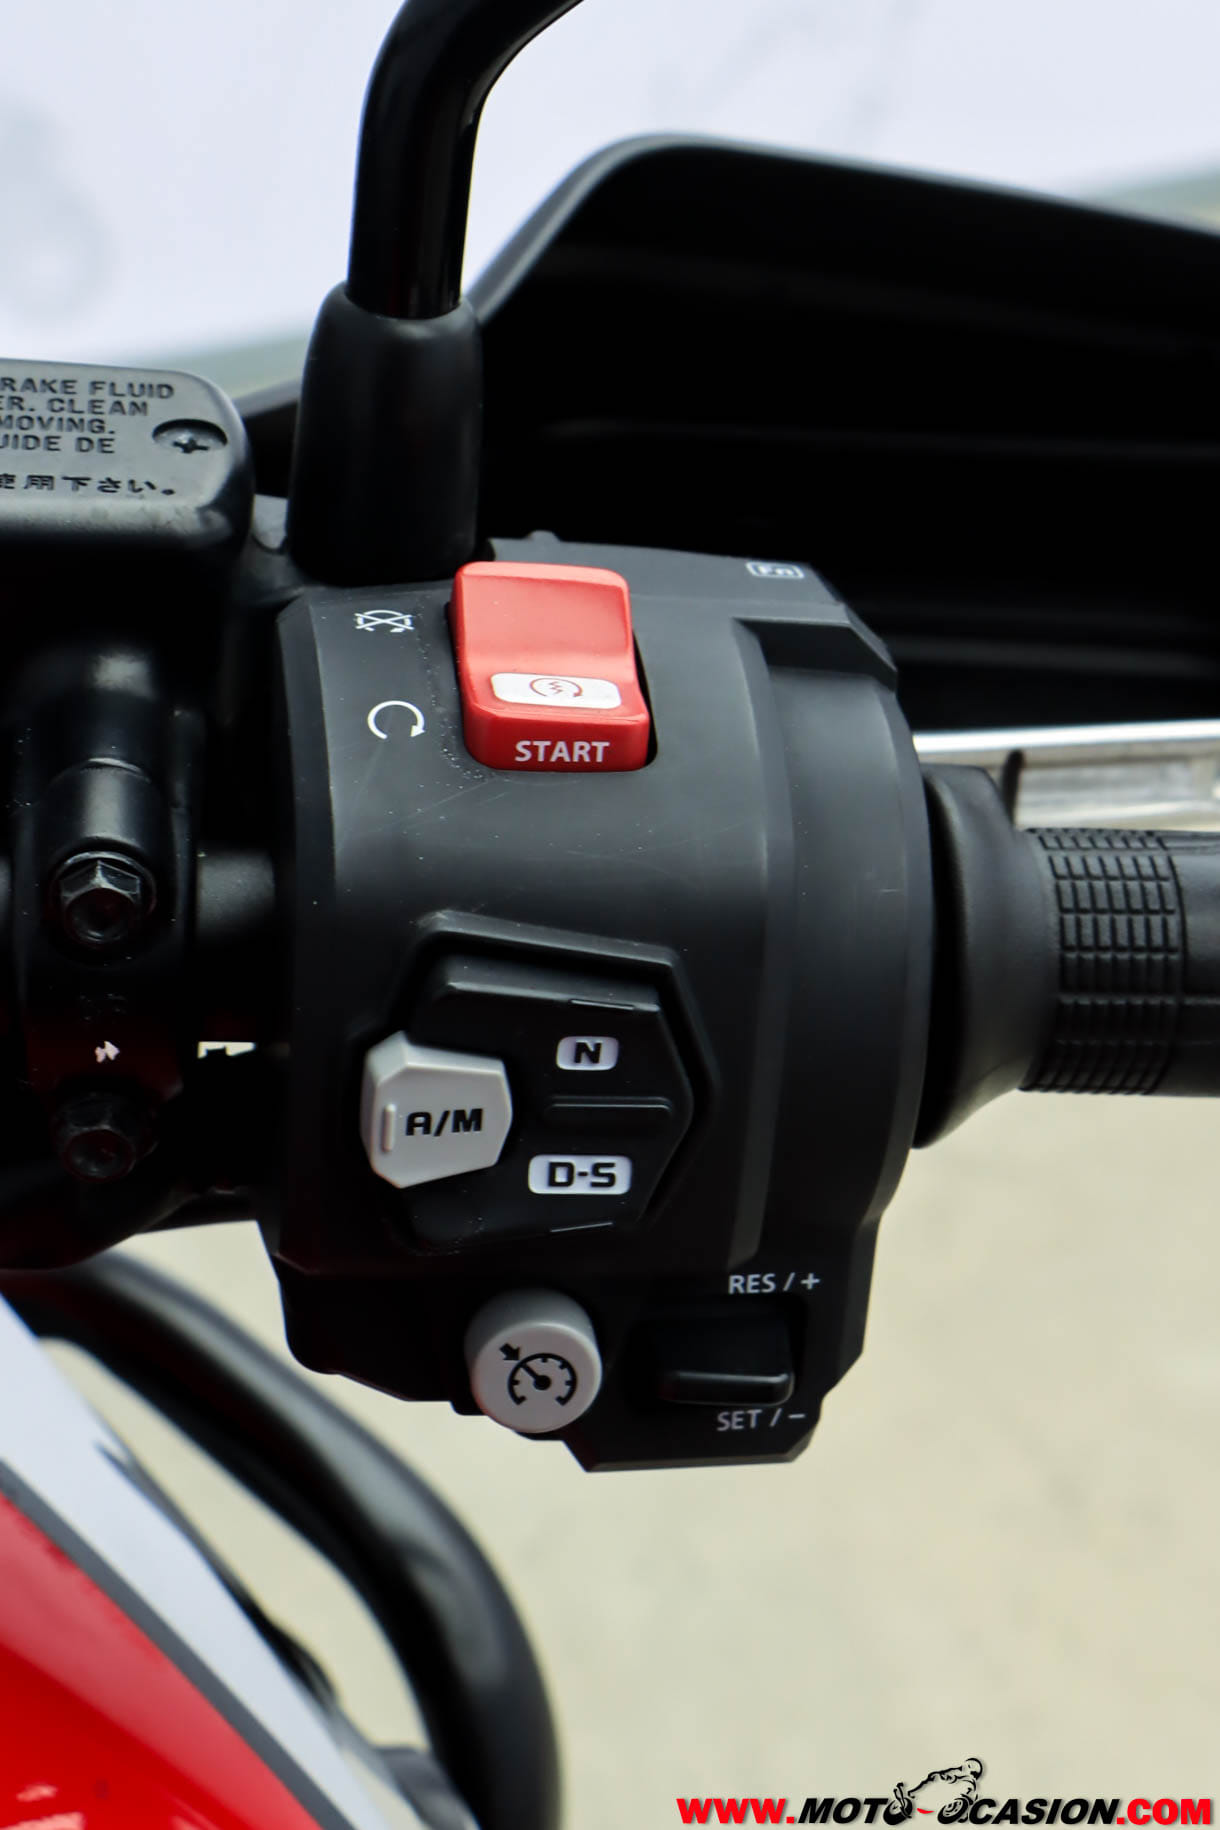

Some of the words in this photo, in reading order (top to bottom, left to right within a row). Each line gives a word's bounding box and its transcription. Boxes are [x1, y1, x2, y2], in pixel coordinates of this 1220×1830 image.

[0, 377, 78, 395] RAKE
[89, 381, 175, 399] FLUID
[48, 397, 148, 416] CLEAN
[75, 436, 116, 454] DE
[514, 740, 611, 763] START
[573, 1040, 603, 1064] N
[405, 1107, 484, 1137] A/M
[547, 1161, 617, 1188] D-S
[728, 1273, 776, 1295] RES
[716, 1409, 763, 1432] SET
